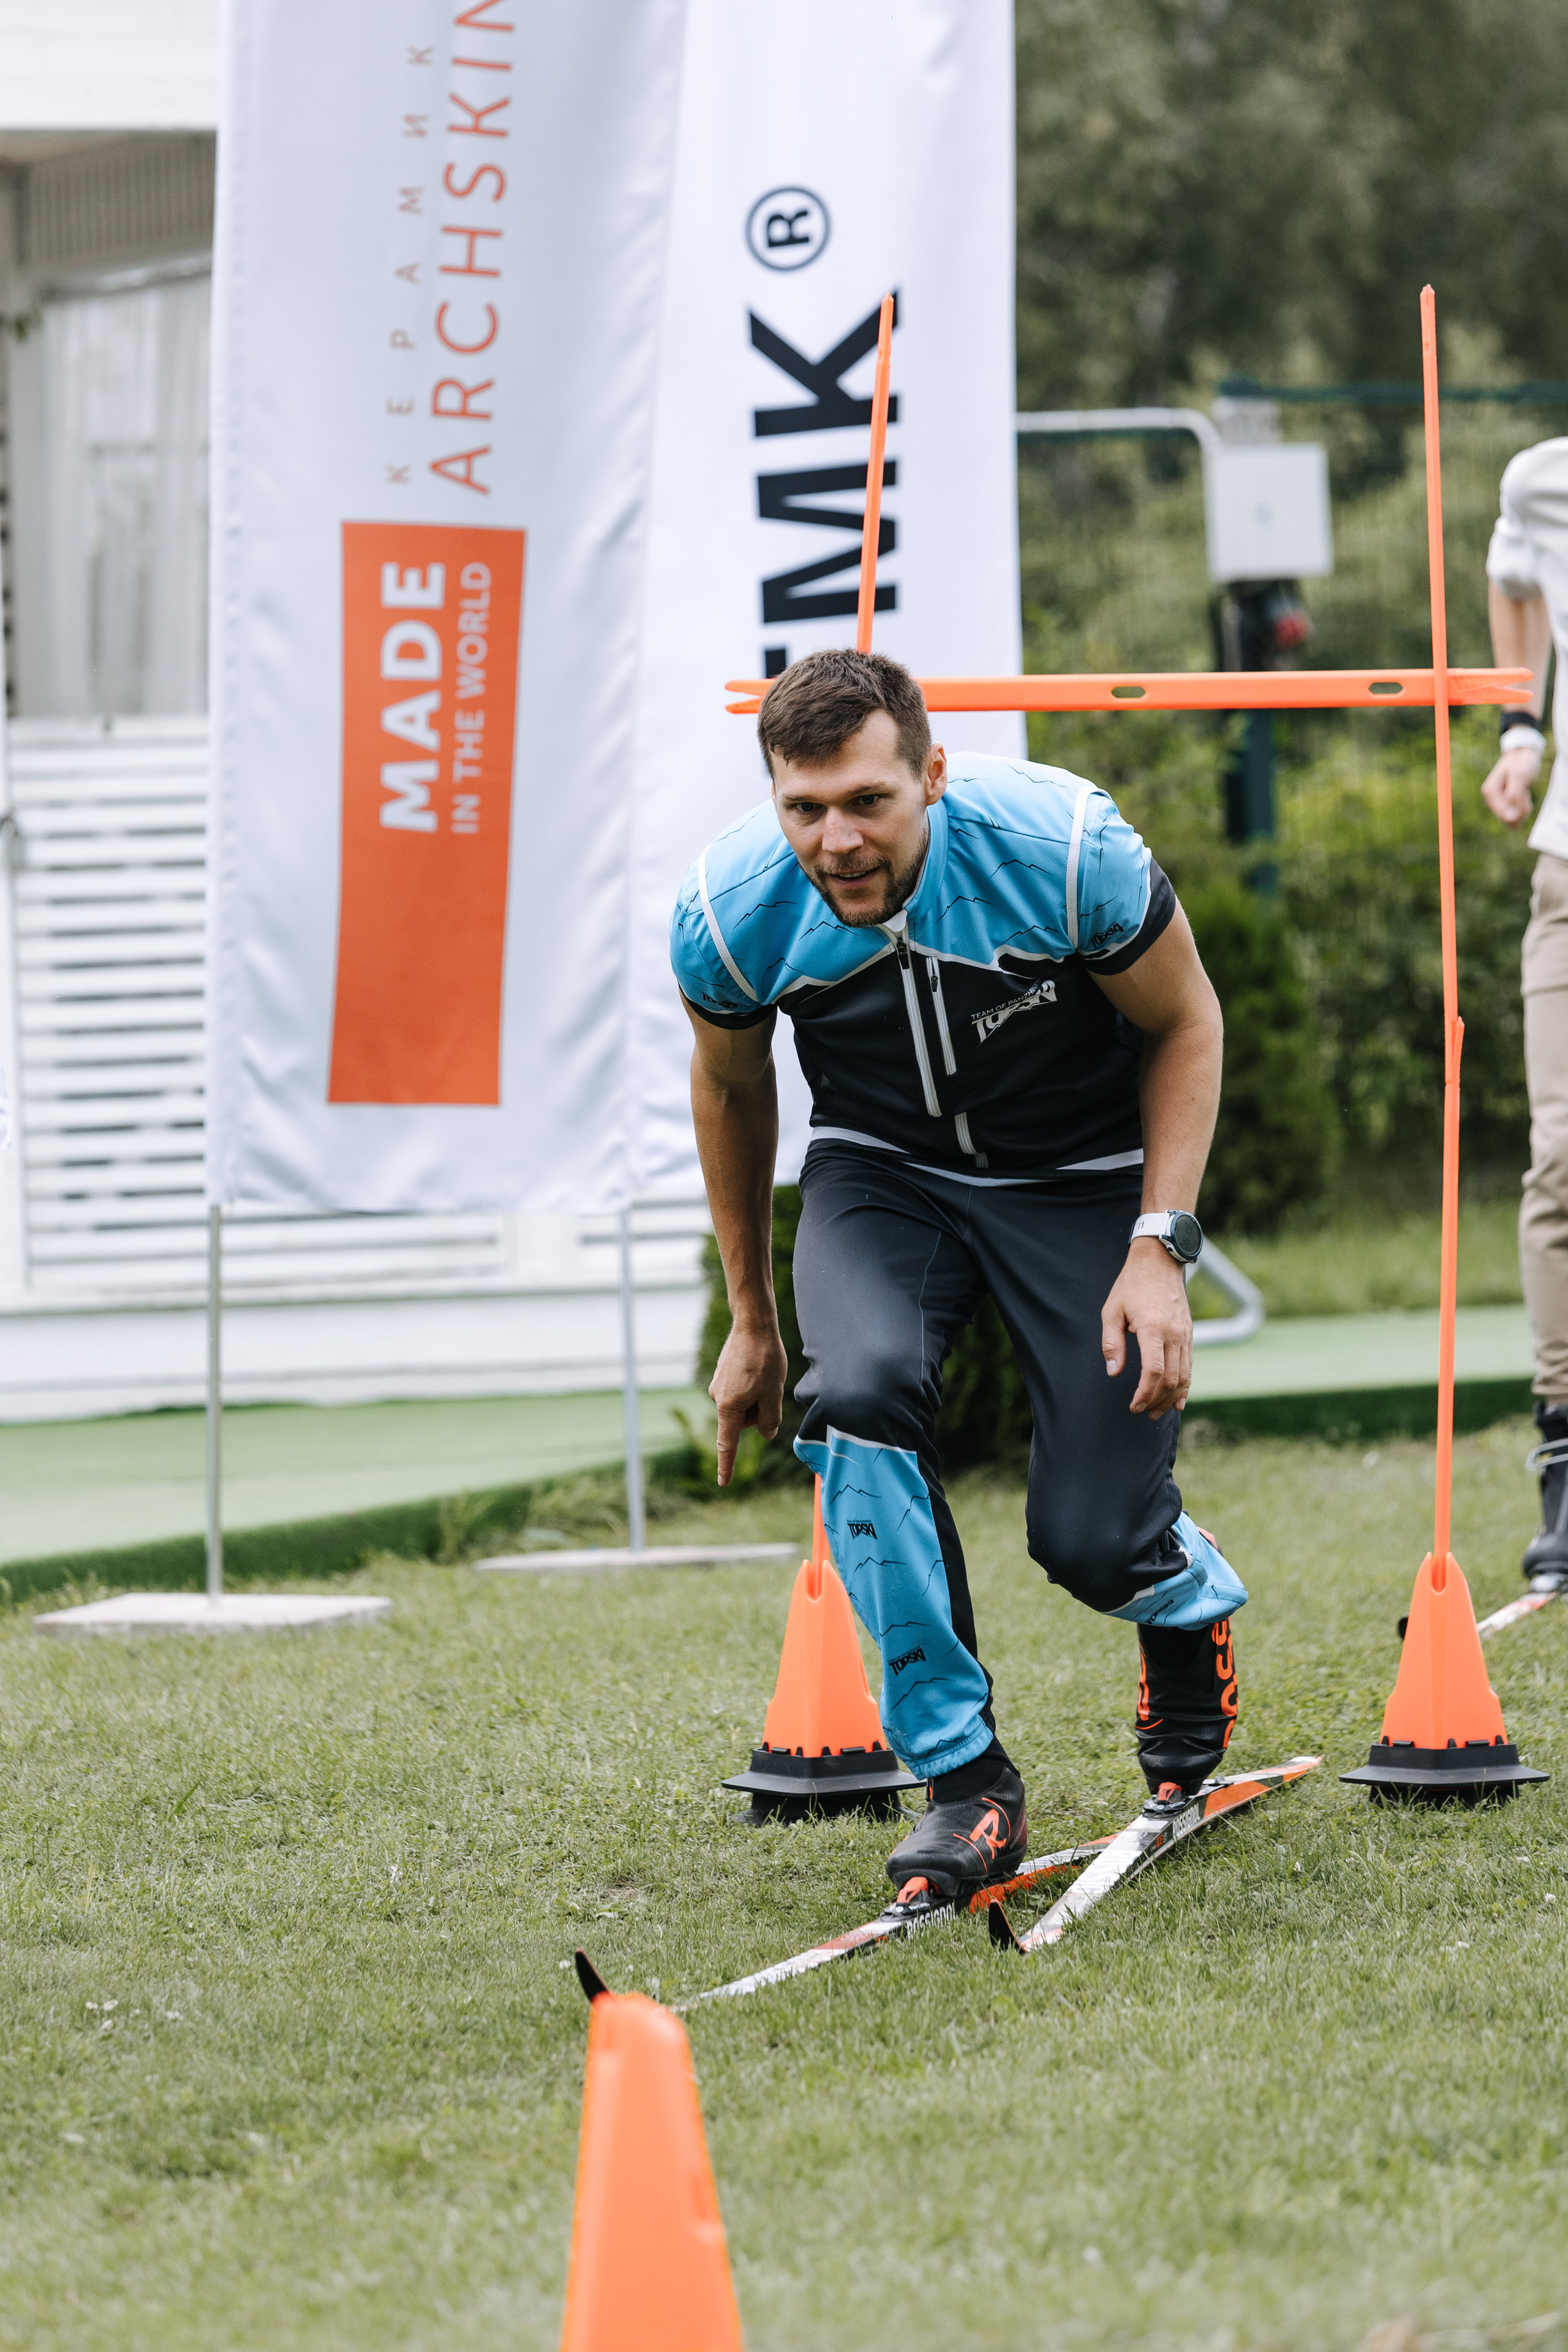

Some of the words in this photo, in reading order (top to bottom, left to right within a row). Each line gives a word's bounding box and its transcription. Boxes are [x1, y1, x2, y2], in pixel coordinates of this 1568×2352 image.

[747, 285, 900, 679] MK
[455, 561, 492, 699] WORLD
[379, 561, 445, 834] MADE
[452, 709, 486, 784] THE
[450, 794, 481, 834] IN
[971, 1008, 994, 1020] TEAM
[995, 1003, 1006, 1011] OF
[889, 1648, 927, 1676] TOPSKI
